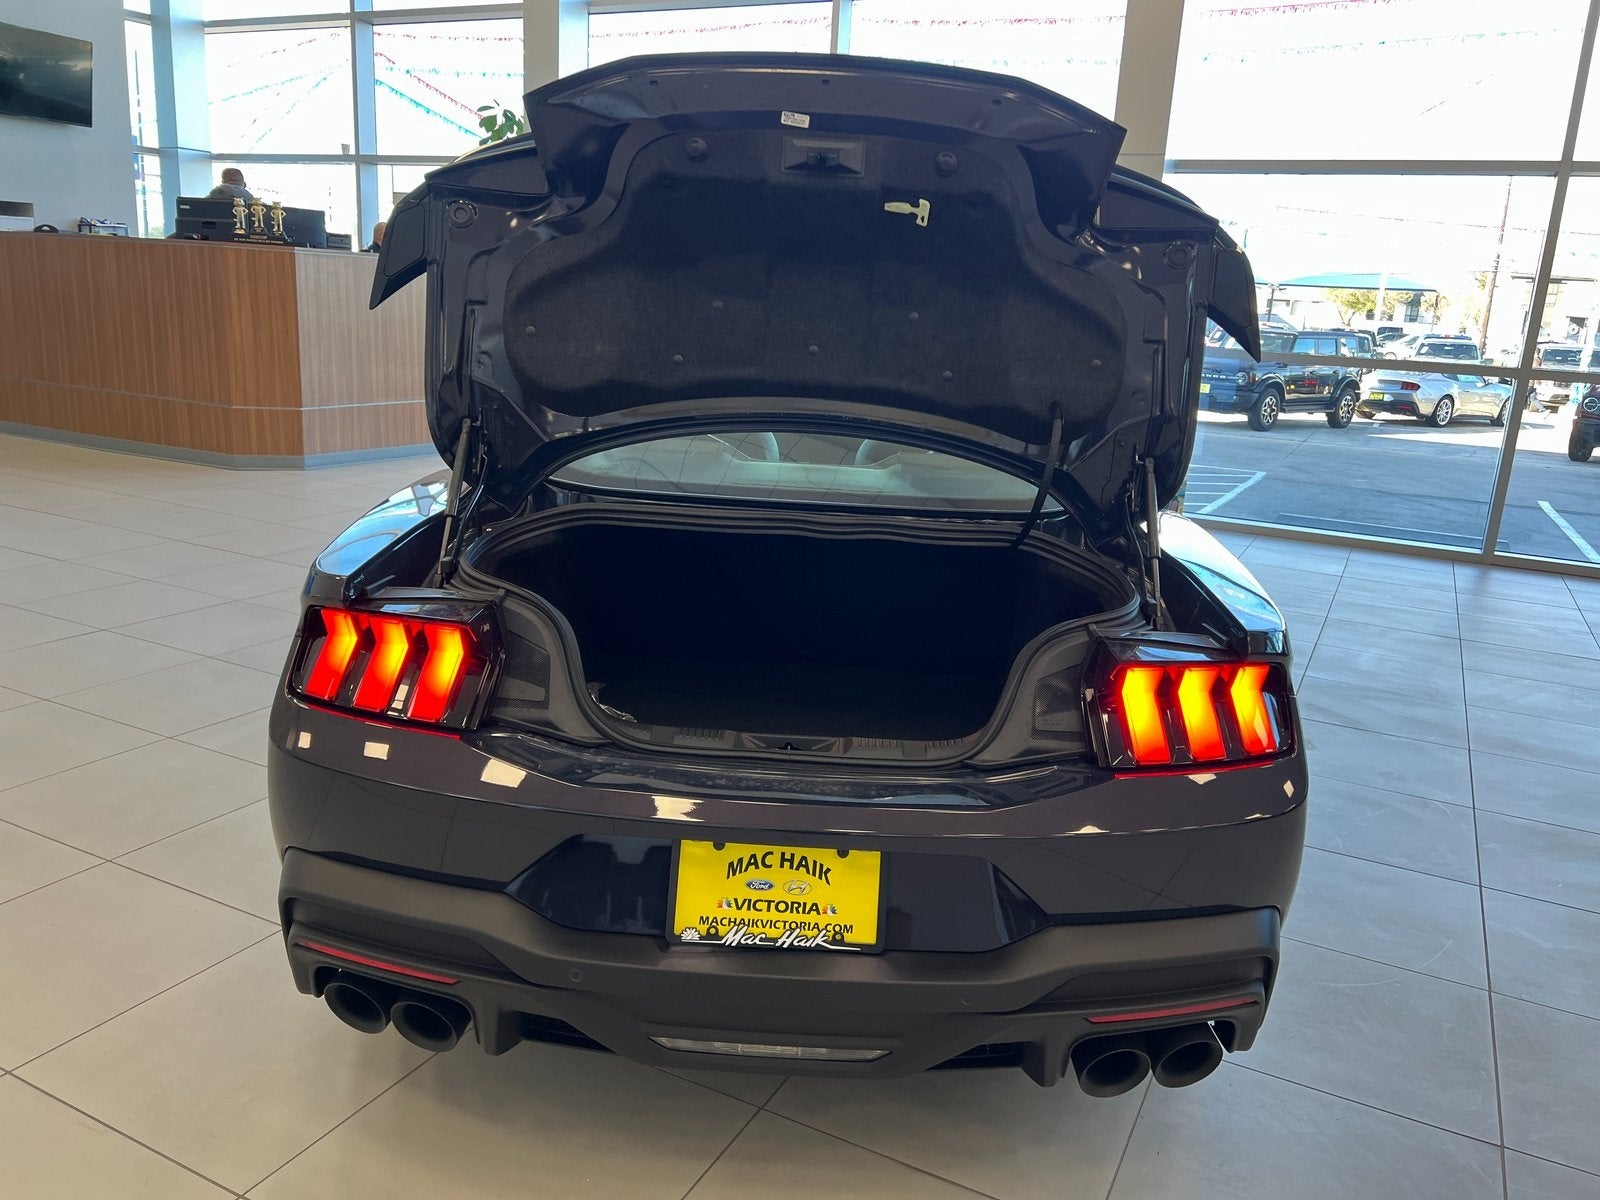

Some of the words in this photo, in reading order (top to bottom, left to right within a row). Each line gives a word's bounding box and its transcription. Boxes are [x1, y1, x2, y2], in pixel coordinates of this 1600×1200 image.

[726, 851, 774, 880] MAC
[779, 851, 832, 886] HAIK
[749, 881, 770, 890] Ford
[733, 898, 822, 916] VICTORIA
[699, 915, 854, 933] MACHAIKVICTORIACOM
[722, 925, 768, 946] Mac
[775, 928, 830, 948] Haik
